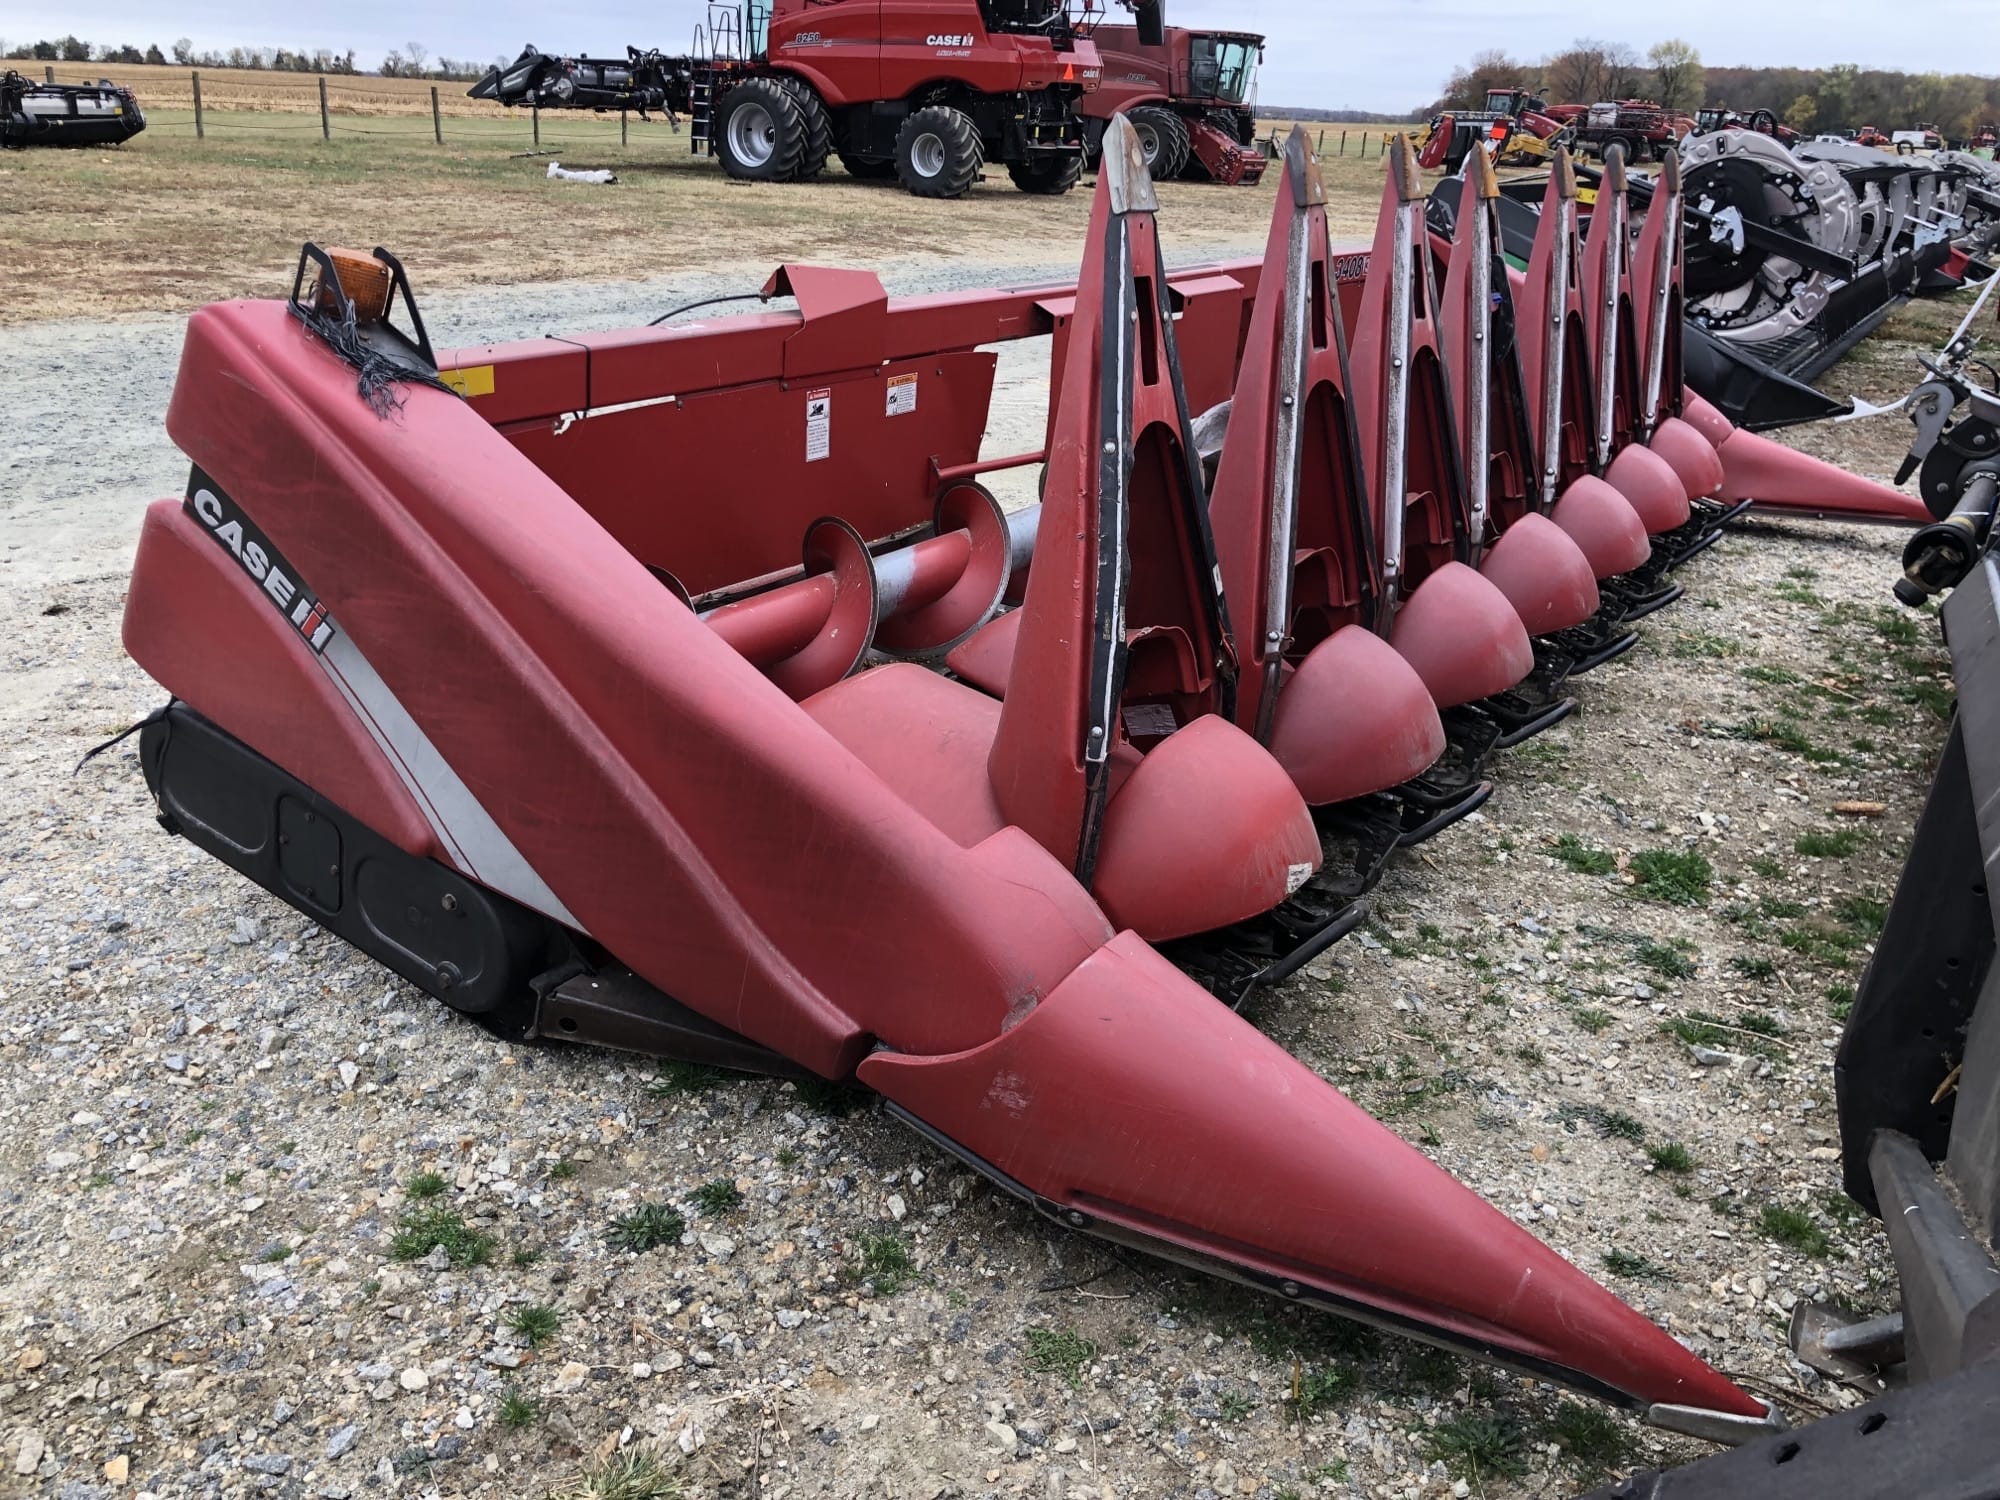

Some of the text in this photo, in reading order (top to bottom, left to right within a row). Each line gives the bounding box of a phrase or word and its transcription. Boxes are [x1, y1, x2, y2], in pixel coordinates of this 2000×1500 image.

[795, 31, 821, 44] 8250
[926, 34, 961, 46] CASE
[194, 488, 296, 610] CASE
